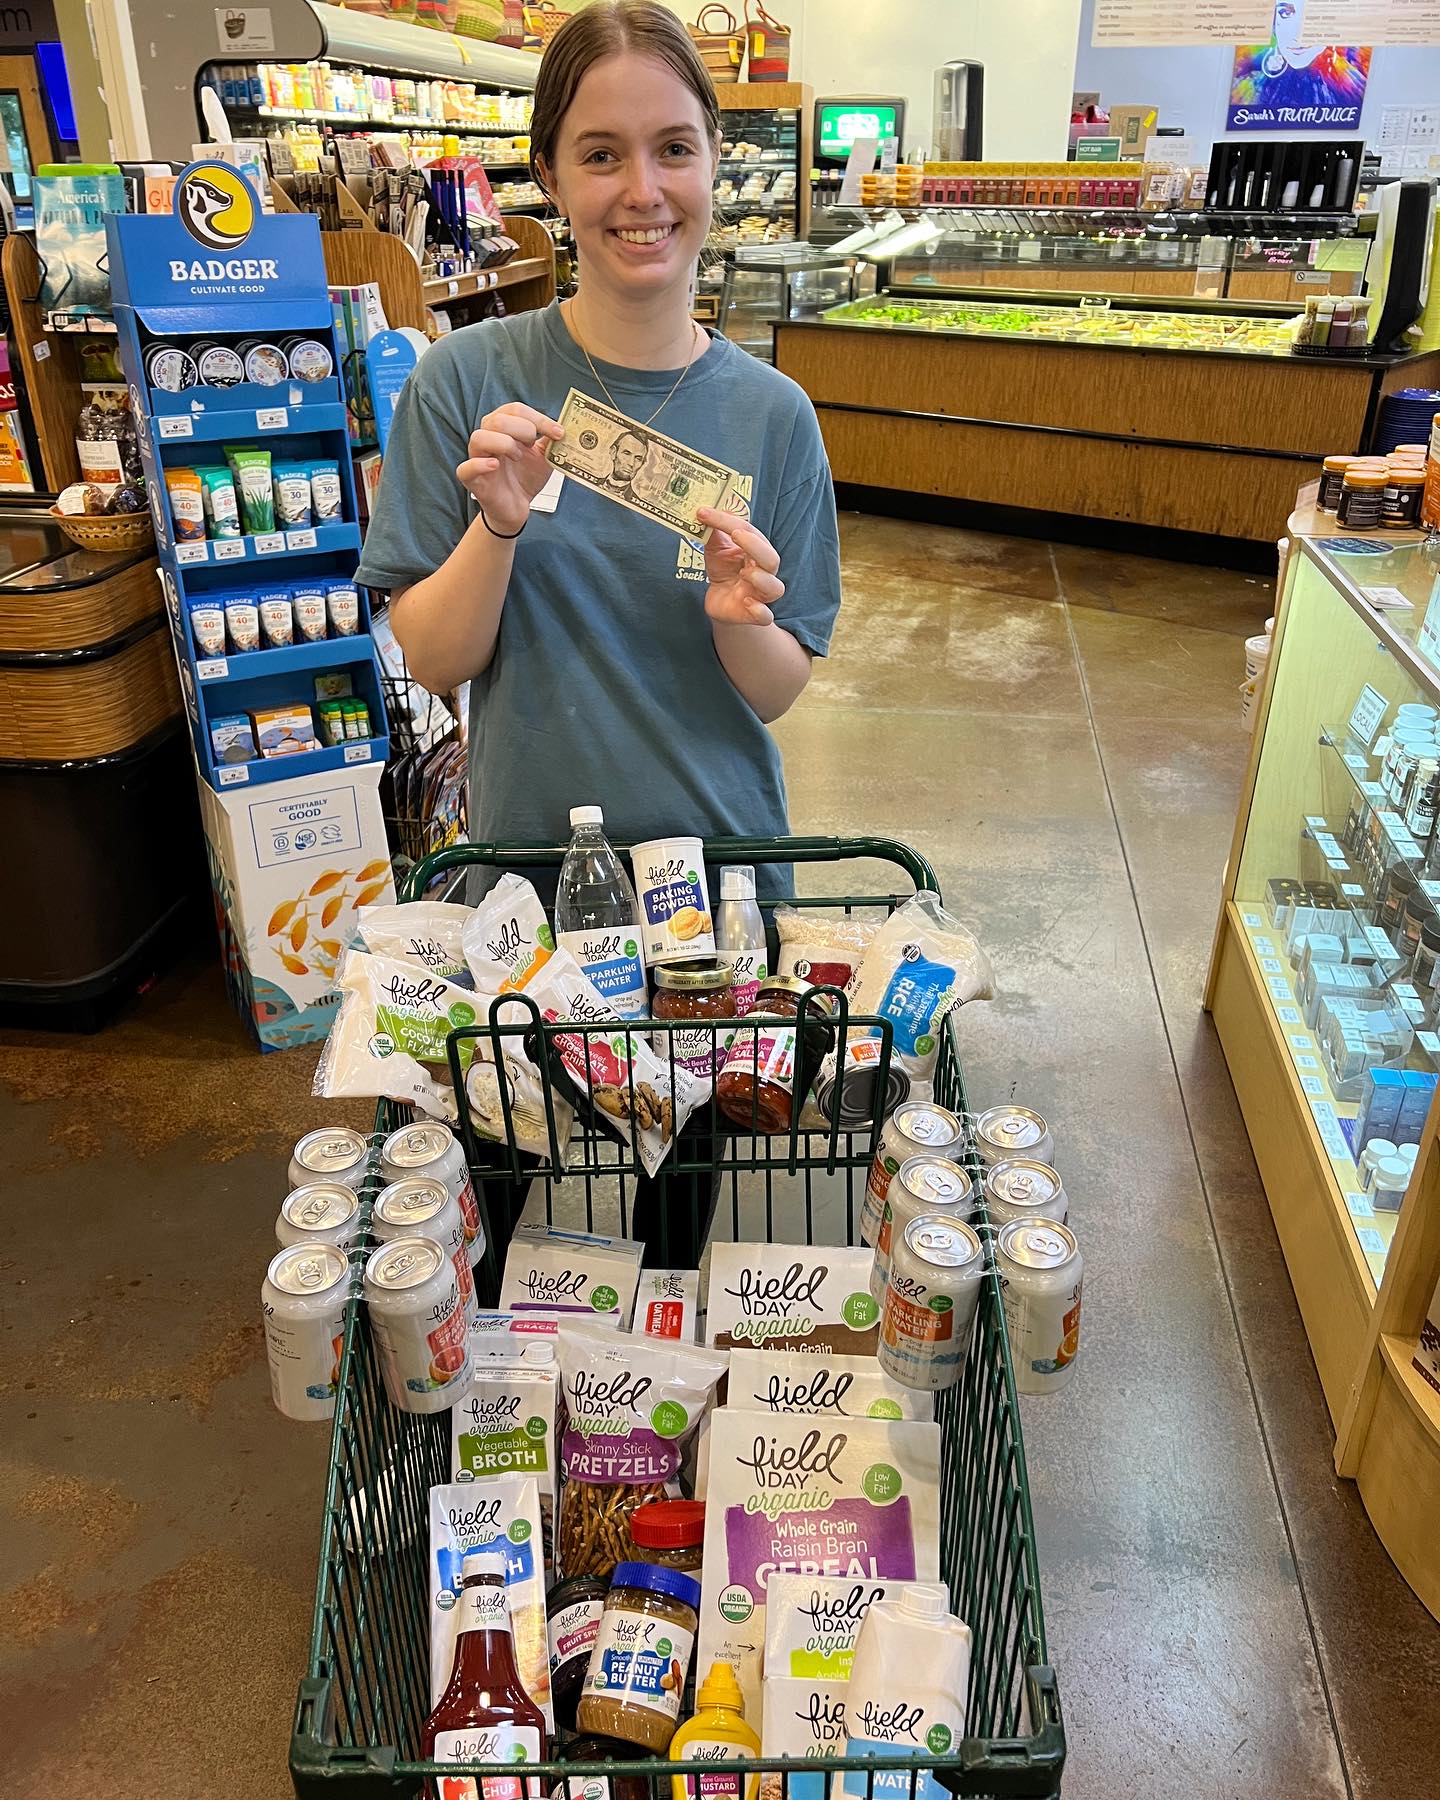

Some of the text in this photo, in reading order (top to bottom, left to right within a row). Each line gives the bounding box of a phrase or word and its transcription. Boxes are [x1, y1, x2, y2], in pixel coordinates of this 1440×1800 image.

[1234, 107, 1358, 124] Sarah's TRUTH JUICE
[169, 260, 279, 281] BADGER
[190, 285, 265, 294] CULTIVATE GOOD
[573, 396, 587, 408] 5
[554, 452, 567, 465] 5
[279, 472, 307, 481] BADGER
[714, 467, 730, 480] 5
[290, 491, 302, 499] 30
[322, 486, 334, 494] 30
[570, 465, 598, 484] FIVE
[631, 496, 685, 527] DOLLARS
[179, 502, 192, 510] 40
[304, 607, 317, 615] 40
[338, 602, 350, 610] 40
[236, 617, 248, 625] 40
[271, 612, 283, 620] 40
[278, 799, 328, 813] CERTIFIABLY
[288, 808, 321, 821] GOOD
[645, 859, 686, 886] field
[656, 877, 672, 885] DAY
[652, 885, 693, 902] BAKING
[652, 895, 698, 914] POWDER
[487, 918, 531, 962] field
[578, 936, 621, 962] field
[591, 954, 609, 962] DAY
[586, 963, 637, 981] SPARKLING
[597, 975, 631, 989] WATER
[381, 975, 448, 1010] field
[887, 977, 916, 1017] RICE
[399, 996, 423, 1008] DAY
[387, 1006, 436, 1021] organic
[408, 1041, 446, 1057] FLAKES
[674, 1047, 708, 1061] organic
[519, 1269, 588, 1302] field
[664, 1273, 684, 1299] field
[724, 1262, 829, 1316] field
[536, 1290, 562, 1302] DAY
[753, 1301, 792, 1317] DAY
[853, 1300, 868, 1309] Low
[853, 1311, 867, 1320] Fat
[733, 1316, 814, 1342] organic
[568, 1371, 652, 1418] field
[754, 1369, 854, 1416] field
[463, 1395, 521, 1424] field
[583, 1400, 617, 1418] DAY
[662, 1411, 676, 1419] Low
[480, 1415, 502, 1424] DAY
[569, 1415, 631, 1438] organic
[662, 1420, 675, 1429] Fat
[469, 1421, 515, 1438] organic
[476, 1438, 528, 1452] Vegetable
[584, 1440, 652, 1458] Skinny Stick
[472, 1451, 537, 1470] BROTH
[570, 1452, 670, 1477] PRETZELS
[736, 1430, 848, 1487] field
[768, 1472, 809, 1489] DAY
[874, 1472, 889, 1481] Low
[747, 1487, 833, 1518] organic
[440, 1499, 502, 1535] field
[459, 1524, 484, 1536] DAY
[776, 1518, 857, 1537] Whole Grain
[448, 1530, 496, 1551] organic
[771, 1537, 867, 1558] Raisin Bran
[473, 1592, 508, 1614] field
[727, 1593, 747, 1603] USDA
[723, 1604, 749, 1613] ORGANIC
[475, 1613, 505, 1625] organic
[557, 1605, 591, 1628] field
[822, 1618, 857, 1633] DAY
[562, 1634, 583, 1651] FRUIT
[621, 1634, 636, 1643] DAY
[611, 1654, 632, 1662] Smooth
[714, 1652, 742, 1661] excellent
[611, 1662, 660, 1677] PEANUT
[733, 1663, 741, 1671] of
[610, 1673, 656, 1689] BUTTER
[856, 1701, 924, 1742] field
[871, 1726, 898, 1741] DAY
[447, 1733, 501, 1764] field
